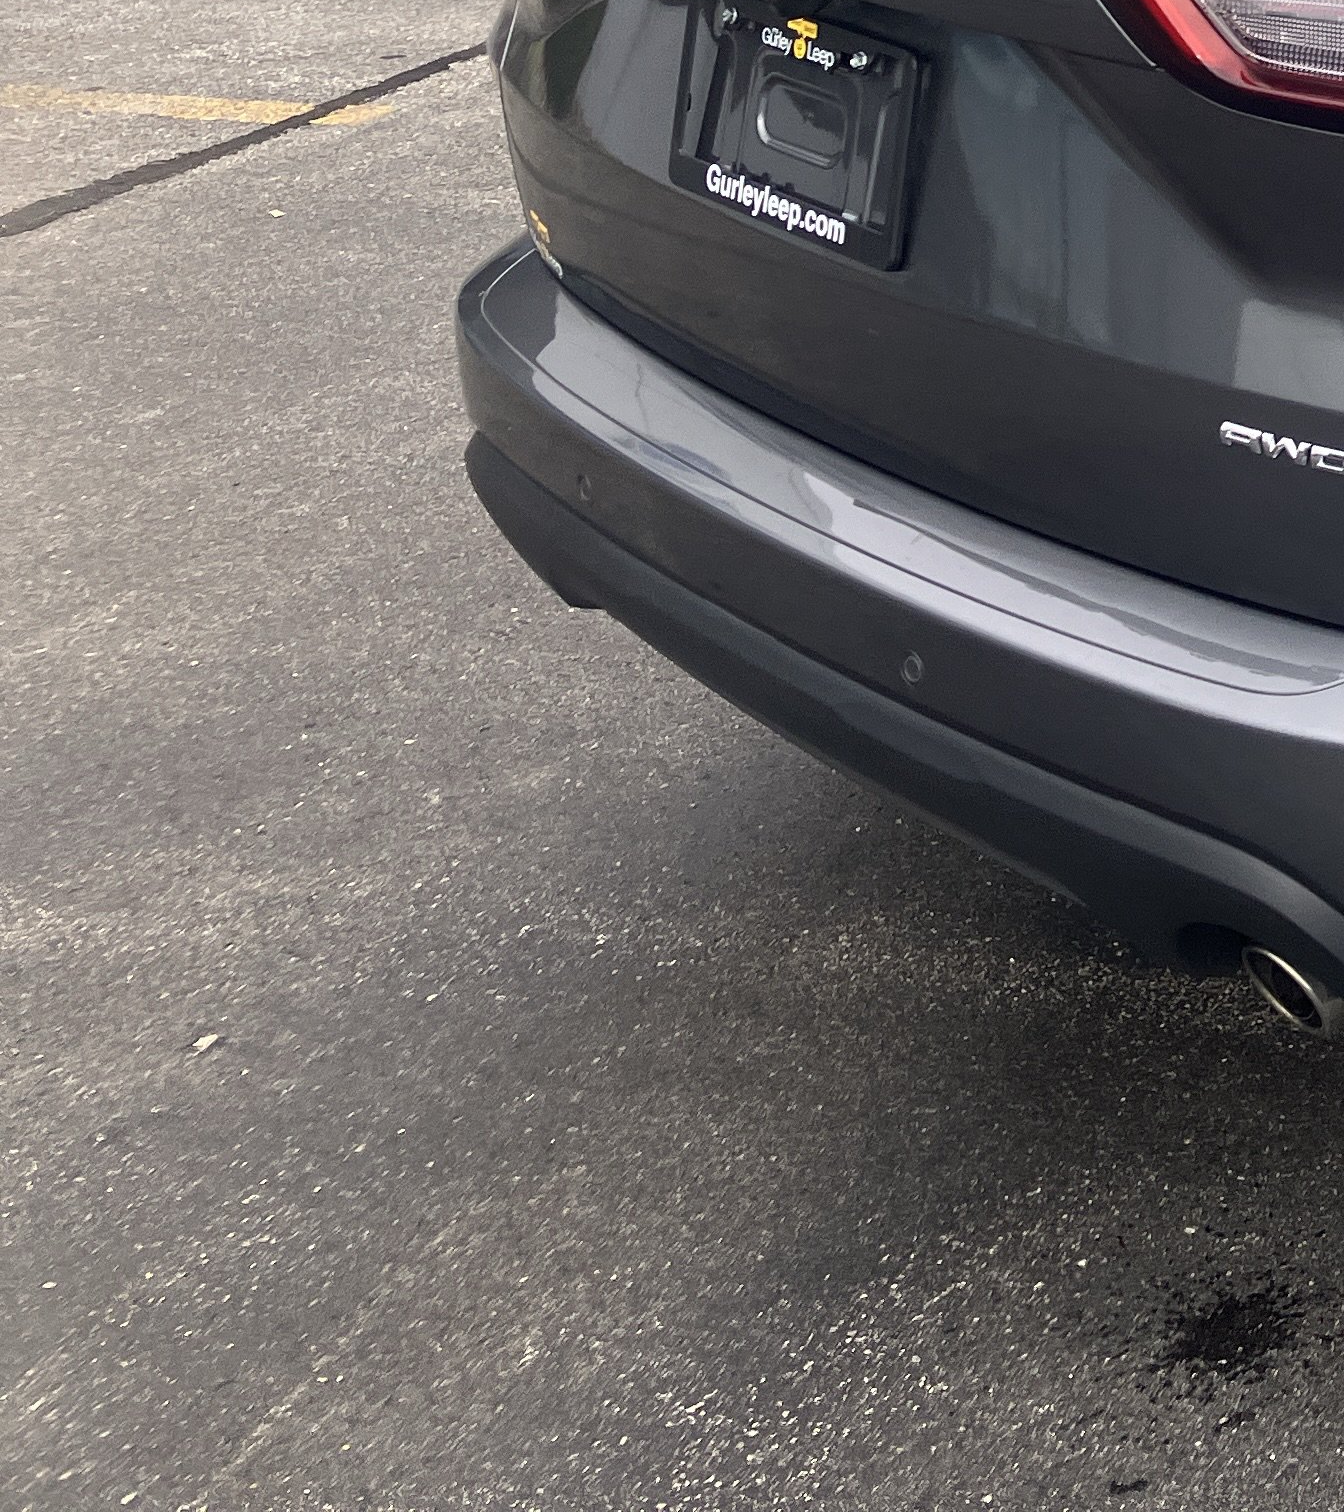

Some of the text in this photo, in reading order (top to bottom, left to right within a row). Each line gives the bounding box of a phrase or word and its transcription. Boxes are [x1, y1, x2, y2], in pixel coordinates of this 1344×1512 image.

[761, 27, 835, 71] Gurley Leep
[706, 163, 846, 245] Gurleyleep.com
